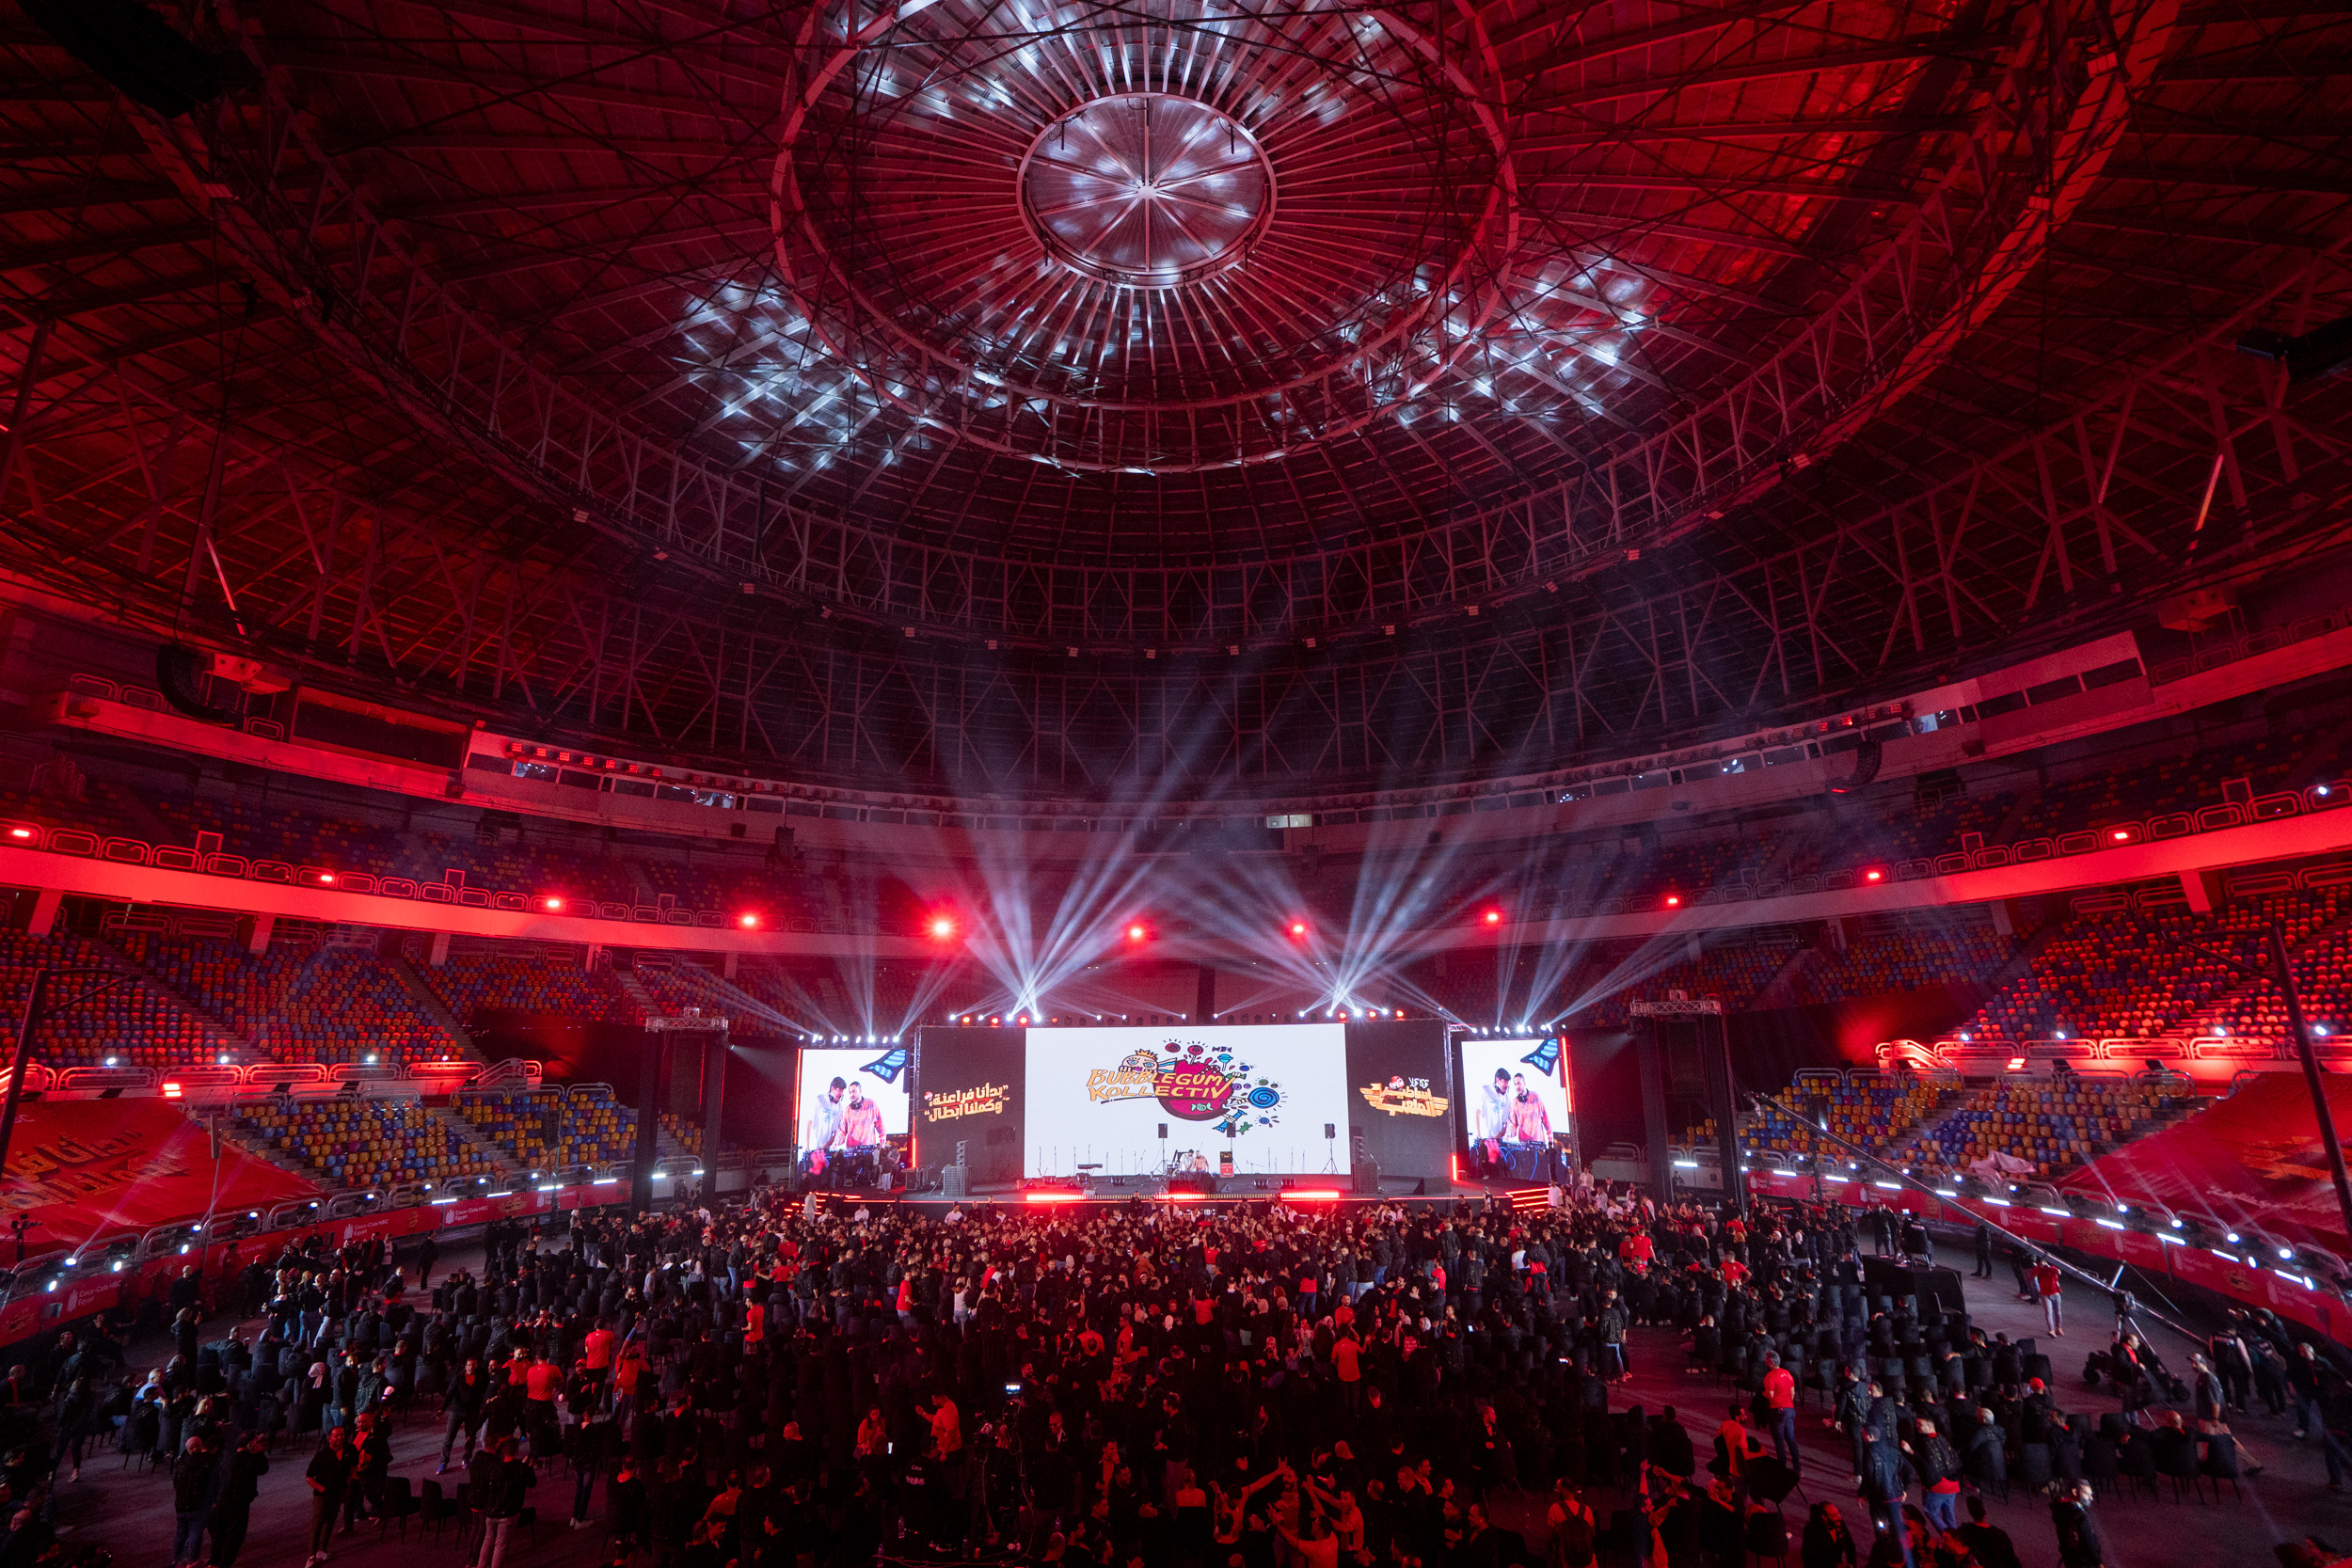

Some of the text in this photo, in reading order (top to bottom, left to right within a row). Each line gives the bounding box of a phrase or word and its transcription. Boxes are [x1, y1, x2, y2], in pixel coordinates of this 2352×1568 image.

[1087, 1069, 1223, 1087] BUBBLEGUM
[1089, 1077, 1236, 1101] KOLLECTIV
[355, 1222, 378, 1230] Coca-Cola
[79, 1279, 122, 1298] Coca-Cola HBC
[77, 1296, 95, 1307] Egypt
